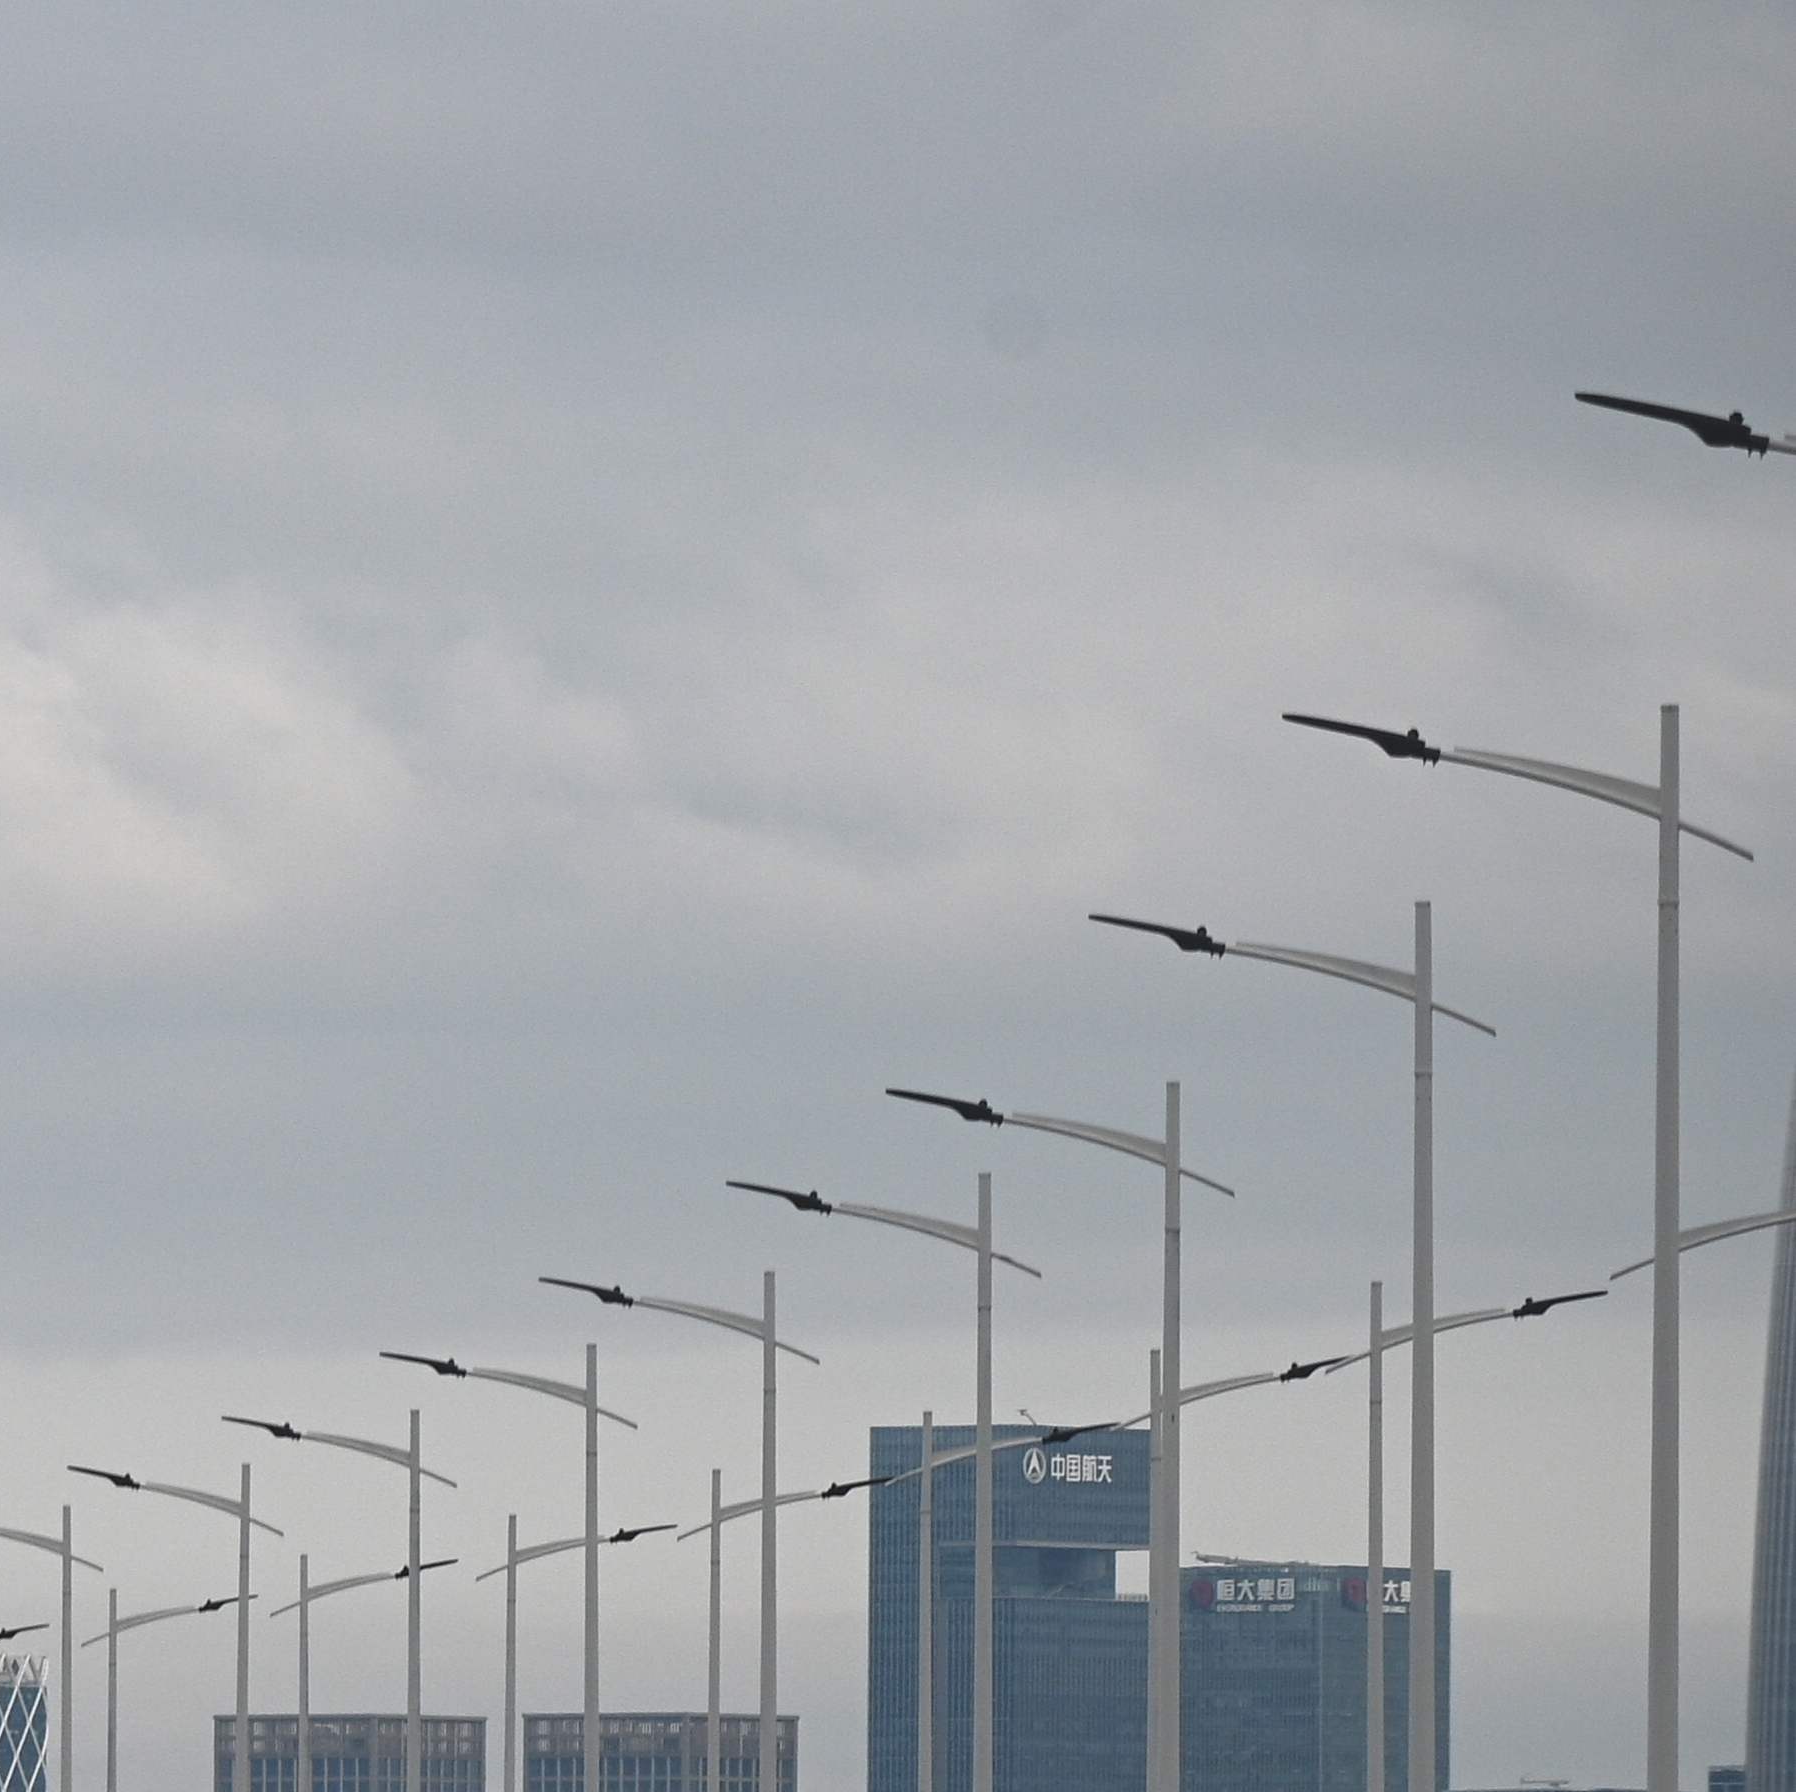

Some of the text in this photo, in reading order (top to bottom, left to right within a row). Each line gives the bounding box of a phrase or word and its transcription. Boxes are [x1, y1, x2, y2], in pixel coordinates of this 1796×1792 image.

[1051, 1453, 1113, 1483] 中国航天
[1216, 1579, 1295, 1601] 恒大集团
